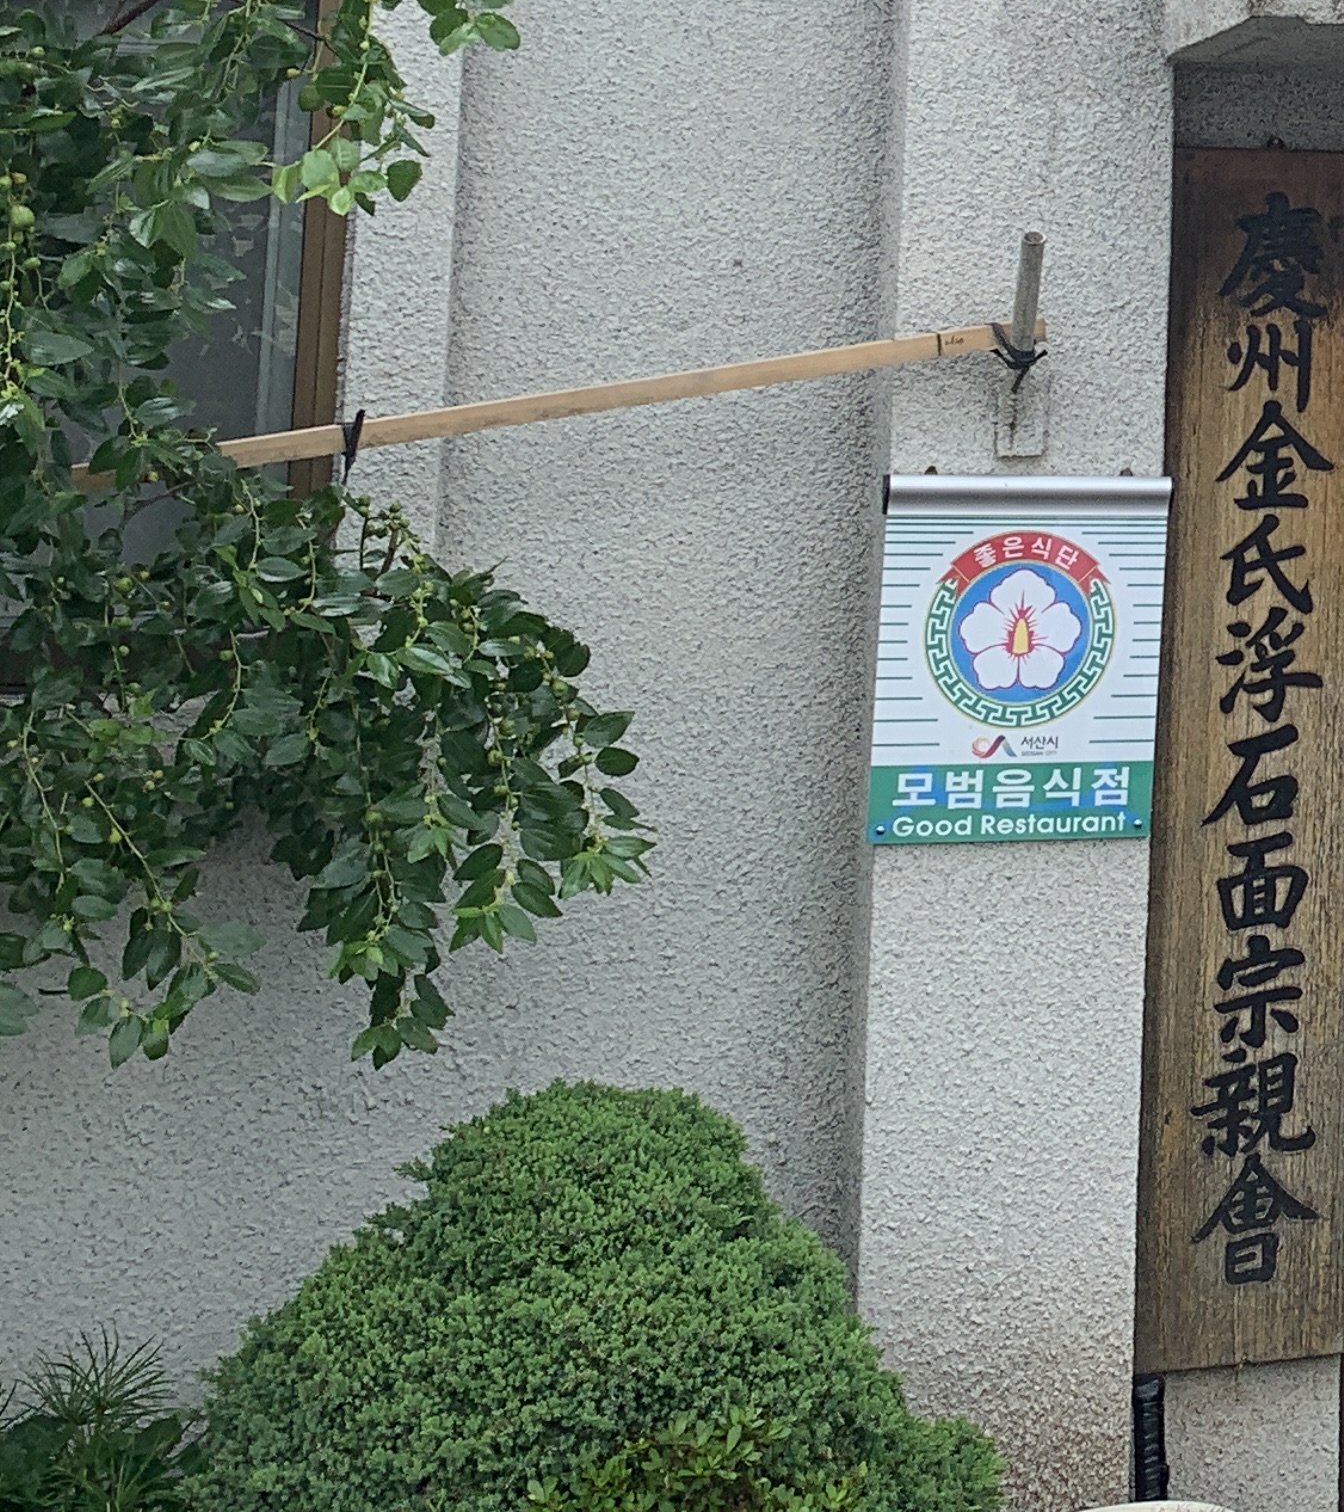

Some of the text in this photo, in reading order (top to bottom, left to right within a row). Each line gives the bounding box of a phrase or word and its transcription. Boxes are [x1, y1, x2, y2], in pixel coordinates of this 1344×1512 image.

[1020, 735, 1059, 750] 서산시
[892, 765, 1131, 810] 모범음식점
[892, 811, 1126, 838] Good Restaurant
